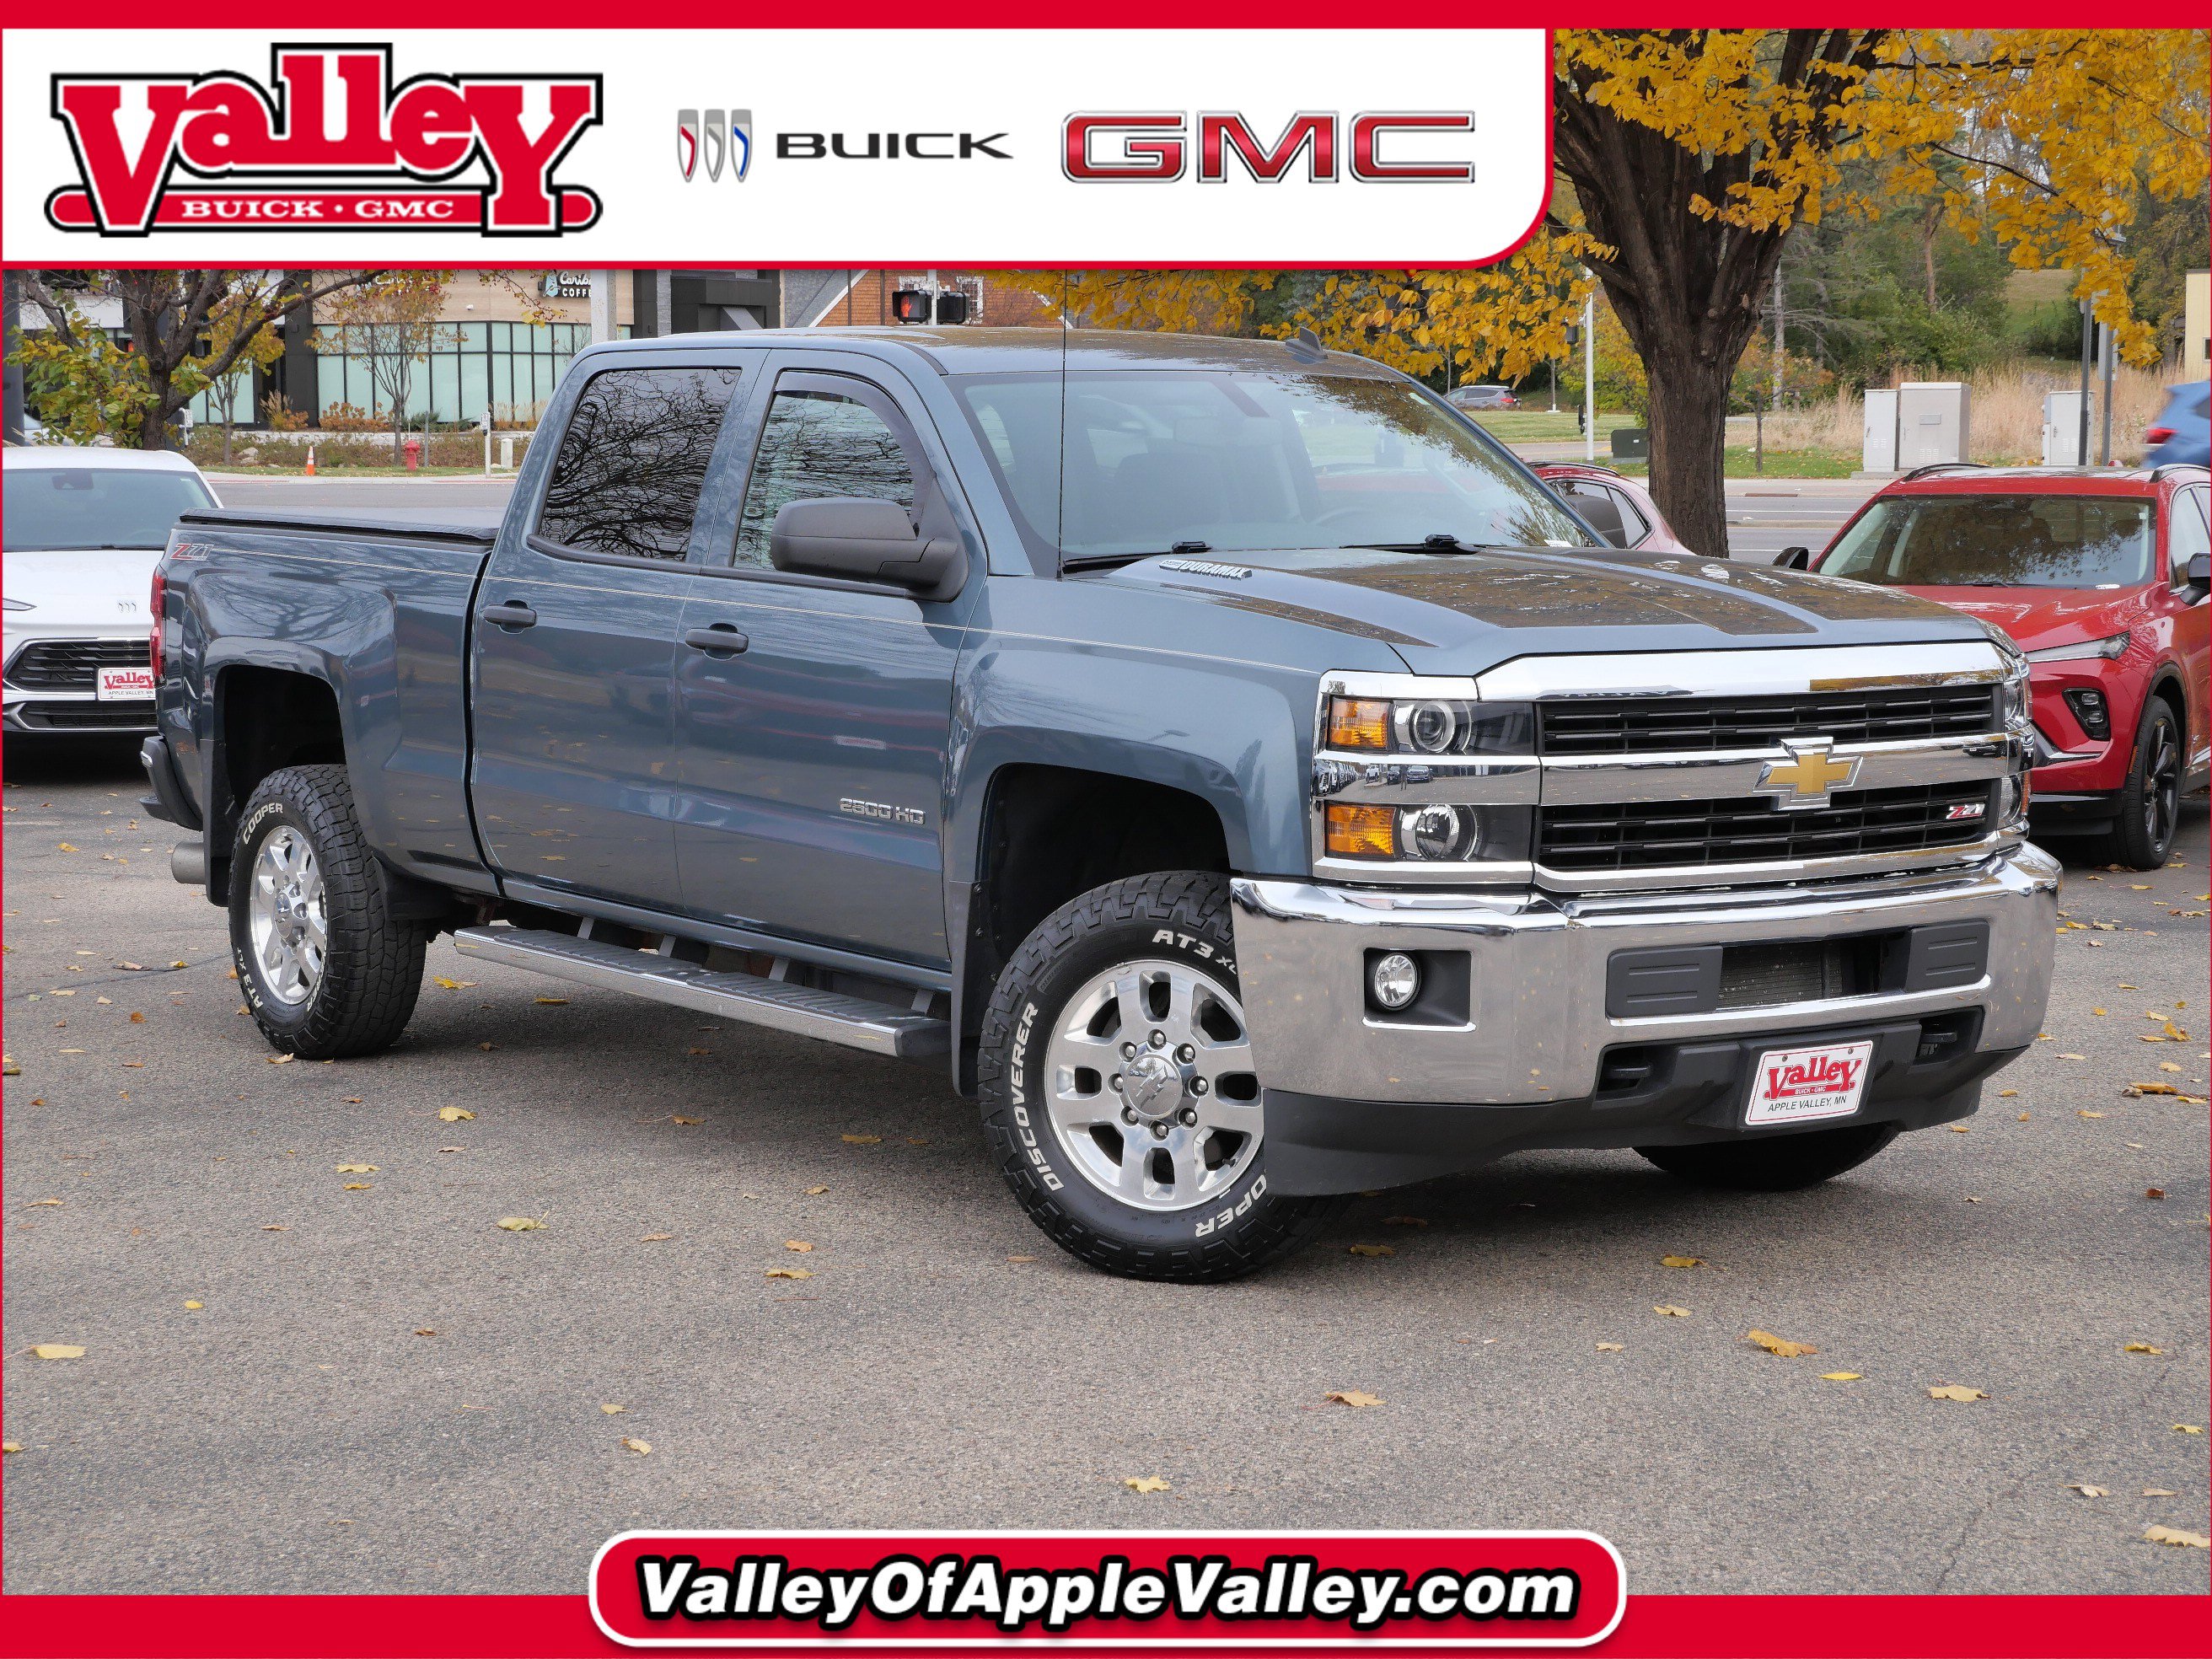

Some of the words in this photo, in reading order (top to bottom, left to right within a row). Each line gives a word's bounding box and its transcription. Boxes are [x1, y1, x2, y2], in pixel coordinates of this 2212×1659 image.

[559, 271, 592, 286] Carib
[562, 287, 592, 298] COFFE
[169, 543, 214, 561] Z71
[1178, 560, 1253, 581] DURAMAX
[104, 672, 154, 690] Valley
[1945, 803, 1986, 820] Z71
[243, 802, 284, 846] COOPER
[1152, 929, 1215, 958] AT3
[1215, 955, 1238, 975] XL
[1768, 1055, 1863, 1101] Valley
[1011, 1001, 1065, 1191] DISCOVERER
[1794, 1087, 1812, 1095] BUICK
[1813, 1085, 1827, 1093] GMC
[1767, 1101, 1797, 1113] APPLE
[1799, 1097, 1833, 1109] VALLEY,
[1834, 1096, 1847, 1105] MN
[1195, 1174, 1267, 1238] OPER
